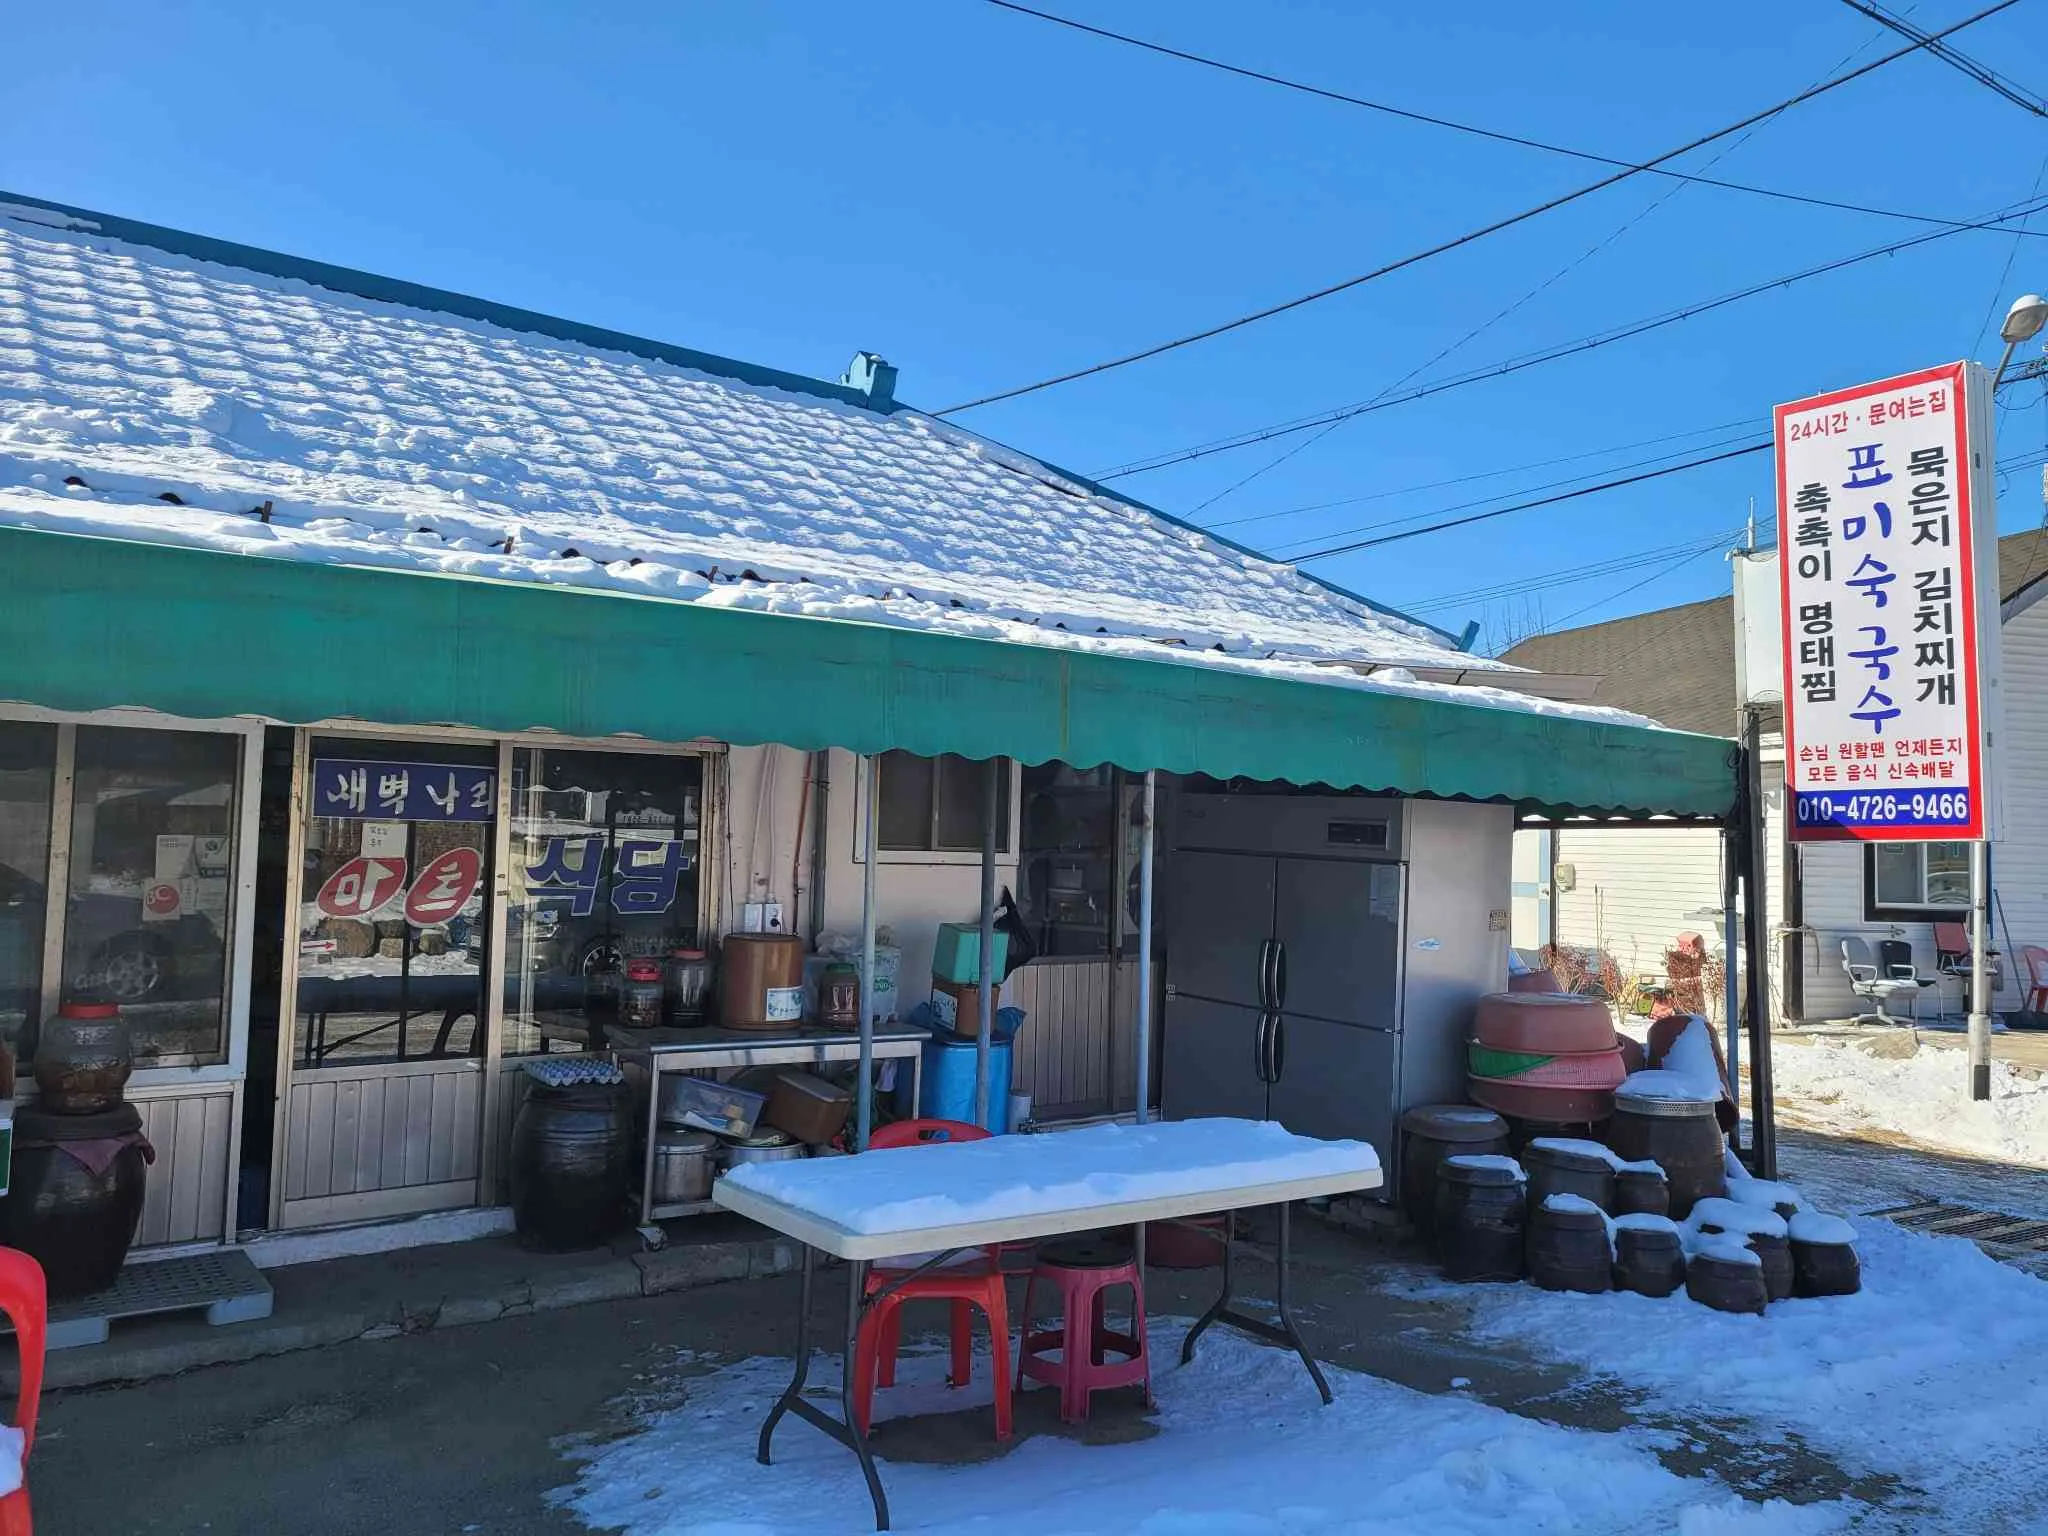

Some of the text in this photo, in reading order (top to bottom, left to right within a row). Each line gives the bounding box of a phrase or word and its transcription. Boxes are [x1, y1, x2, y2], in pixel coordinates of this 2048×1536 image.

[1790, 387, 1948, 442] 24시간 문여는집
[1794, 482, 1836, 703] 촉촉이 명태찜
[1906, 446, 1956, 705] 묵은지 김치찌개
[1799, 737, 1963, 761] 손님 원할땐 언제든지
[1807, 760, 1954, 782] 모든 음식 신속배달
[1798, 793, 1968, 821] 010-4726-9466
[525, 837, 691, 917] 식당
